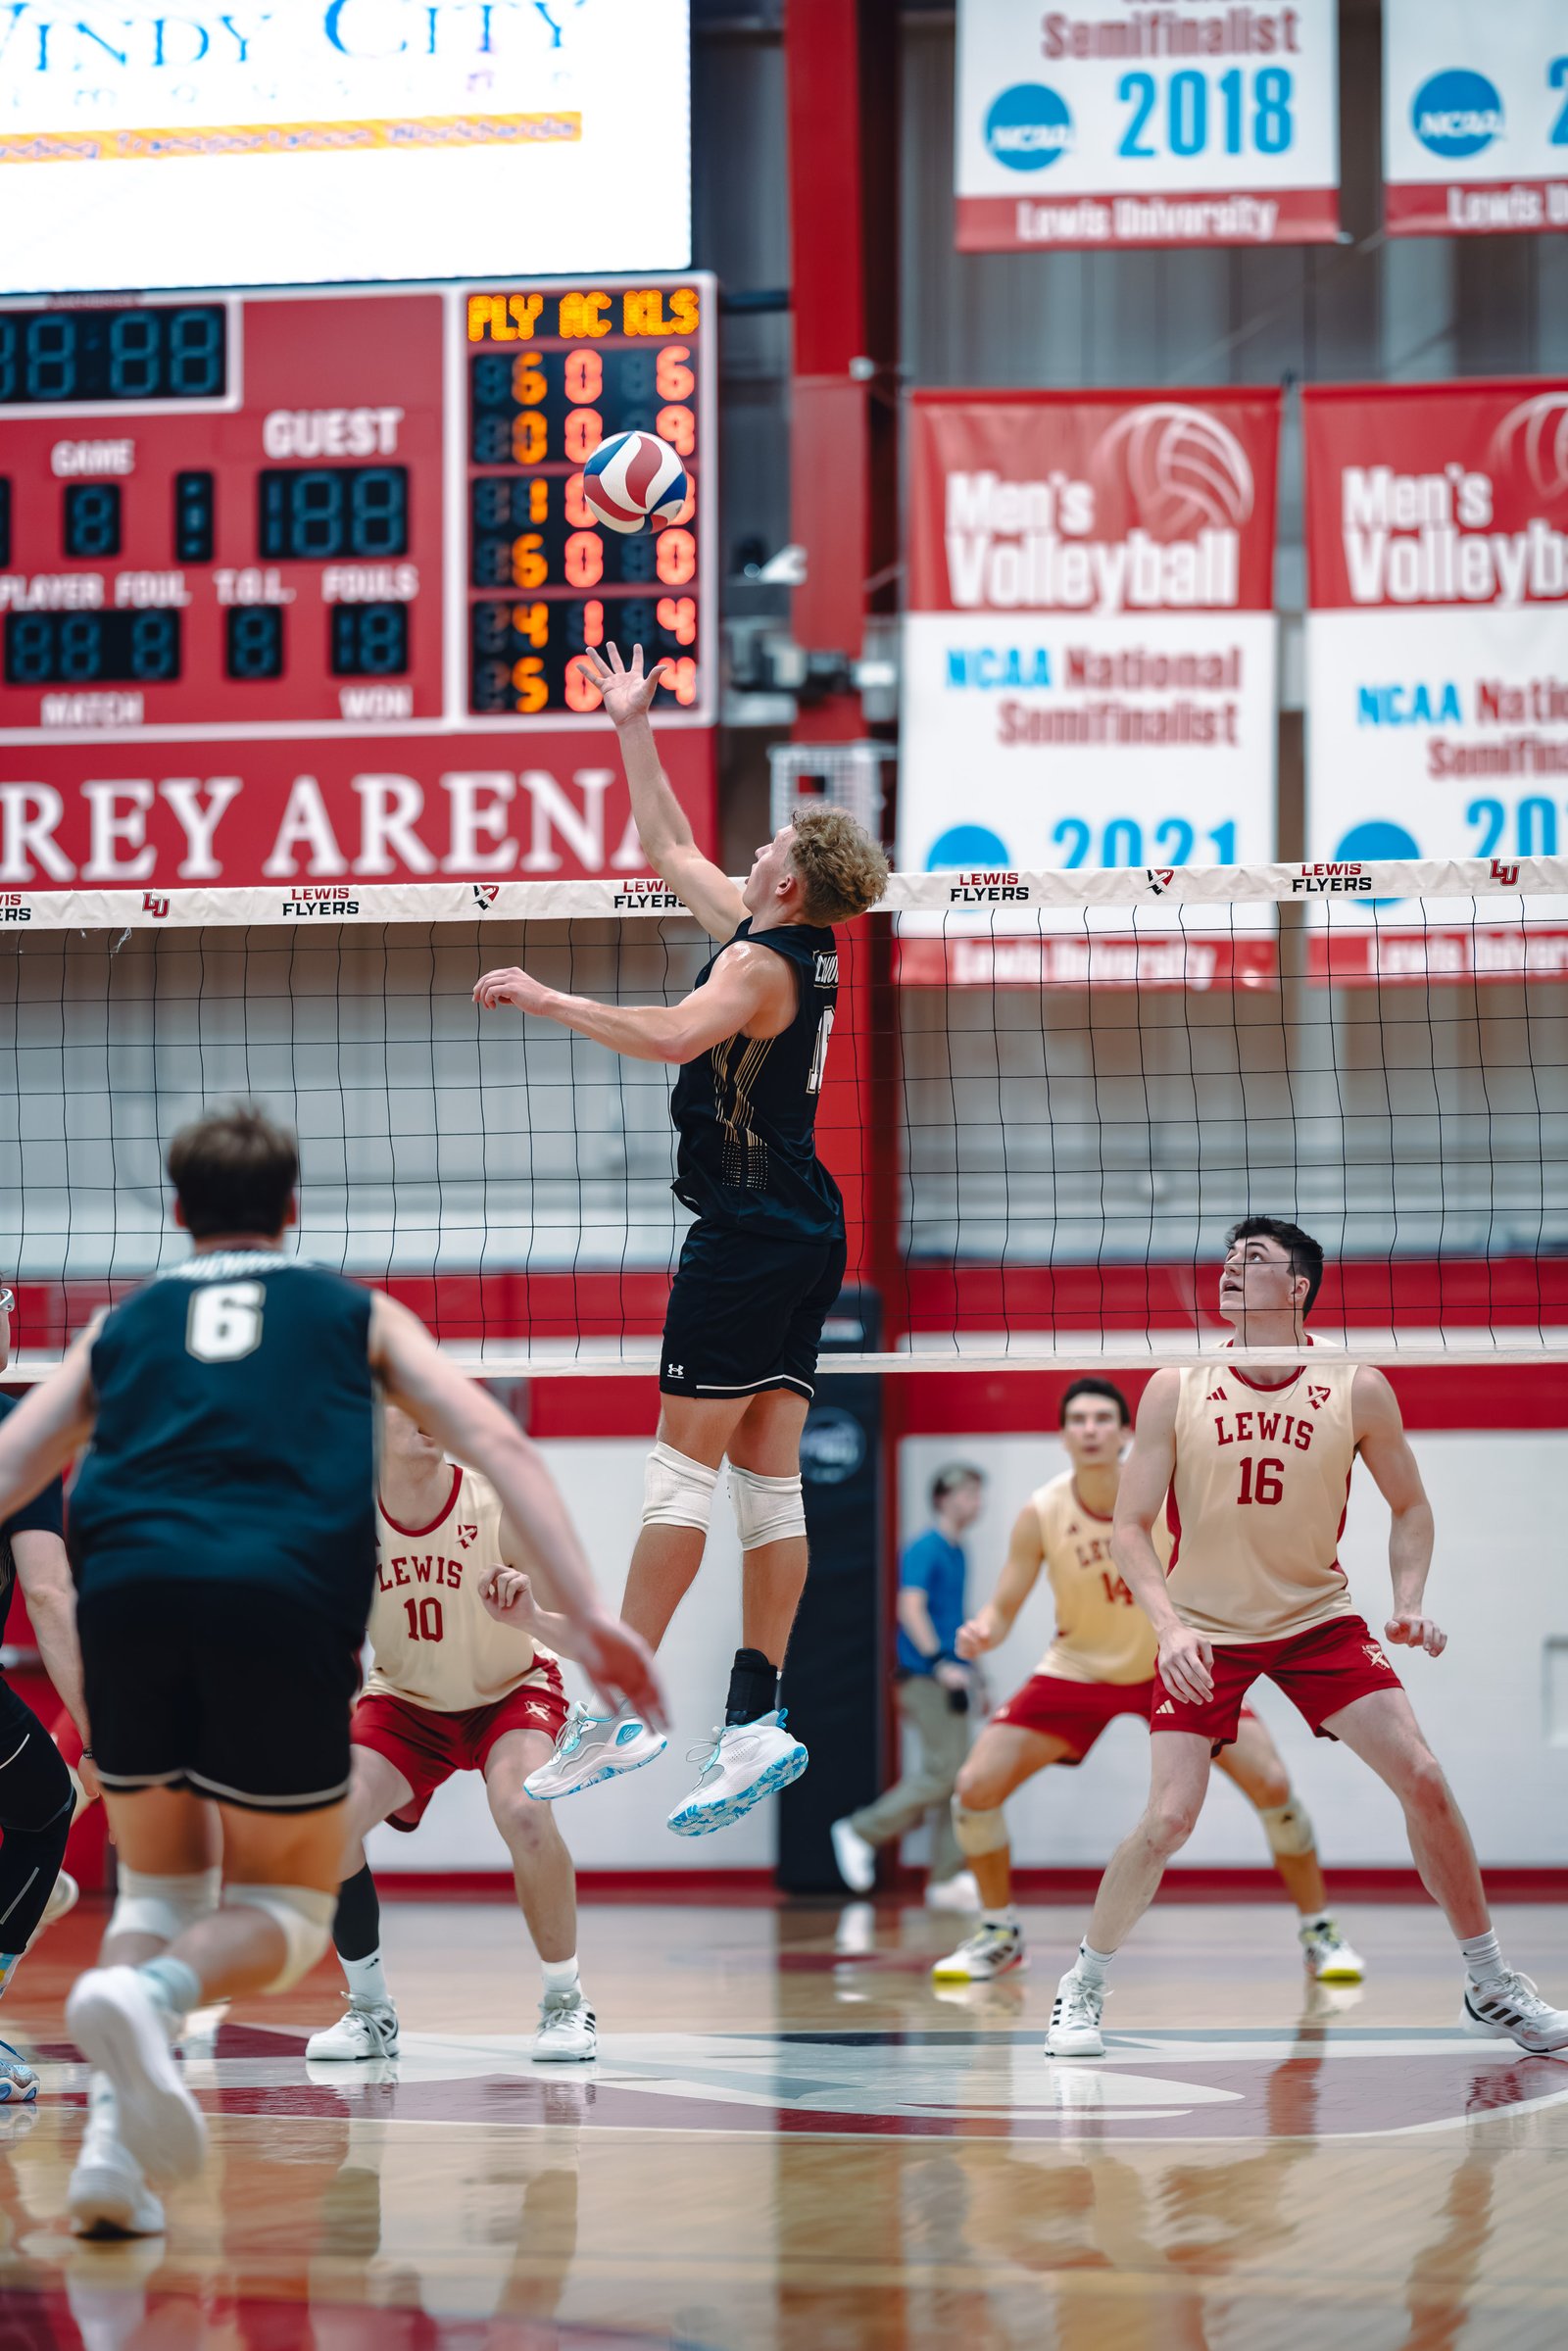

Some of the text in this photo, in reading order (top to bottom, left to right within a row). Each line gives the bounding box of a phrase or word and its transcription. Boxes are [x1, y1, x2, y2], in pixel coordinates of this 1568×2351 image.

[1042, 8, 1299, 59] Semifinalist
[1115, 67, 1294, 159] 2018
[1419, 110, 1505, 139] NCAA
[991, 123, 1077, 153] NCAA
[1016, 198, 1111, 242] Lewis
[1446, 184, 1543, 228] Lewis
[468, 293, 544, 341] PLY
[512, 346, 695, 406] 6 0 6
[263, 406, 405, 459] GUEST
[656, 405, 695, 456] 9
[51, 438, 135, 477] GAME
[945, 468, 1095, 535] Men's
[1342, 463, 1494, 529] Men's
[512, 529, 695, 588] 6 0 0
[945, 525, 1240, 613] Volleyball
[1342, 515, 1568, 610] Volleyb
[0, 572, 105, 611] PLAYER
[321, 564, 420, 603] FOULS
[512, 601, 548, 649] 4
[657, 598, 696, 645] 4
[512, 657, 549, 712] 5
[946, 644, 1241, 690] NCAA National
[997, 699, 1239, 747] Semifinalist
[1358, 683, 1462, 725] NCAA
[0, 775, 244, 883] REY
[1052, 817, 1237, 868] 2021
[1465, 797, 1568, 858] 20
[959, 872, 1019, 886] LEWIS
[1292, 876, 1372, 893] FLYERS
[1301, 862, 1362, 877] LEWIS
[282, 901, 360, 916] FLYERS
[291, 887, 350, 903] LEWIS
[950, 886, 1029, 903] FLYERS
[185, 1278, 267, 1364] 6
[1214, 1411, 1314, 1451] LEWIS
[1237, 1456, 1285, 1506] 16
[376, 1555, 464, 1592] LEWIS
[404, 1596, 444, 1643] 10
